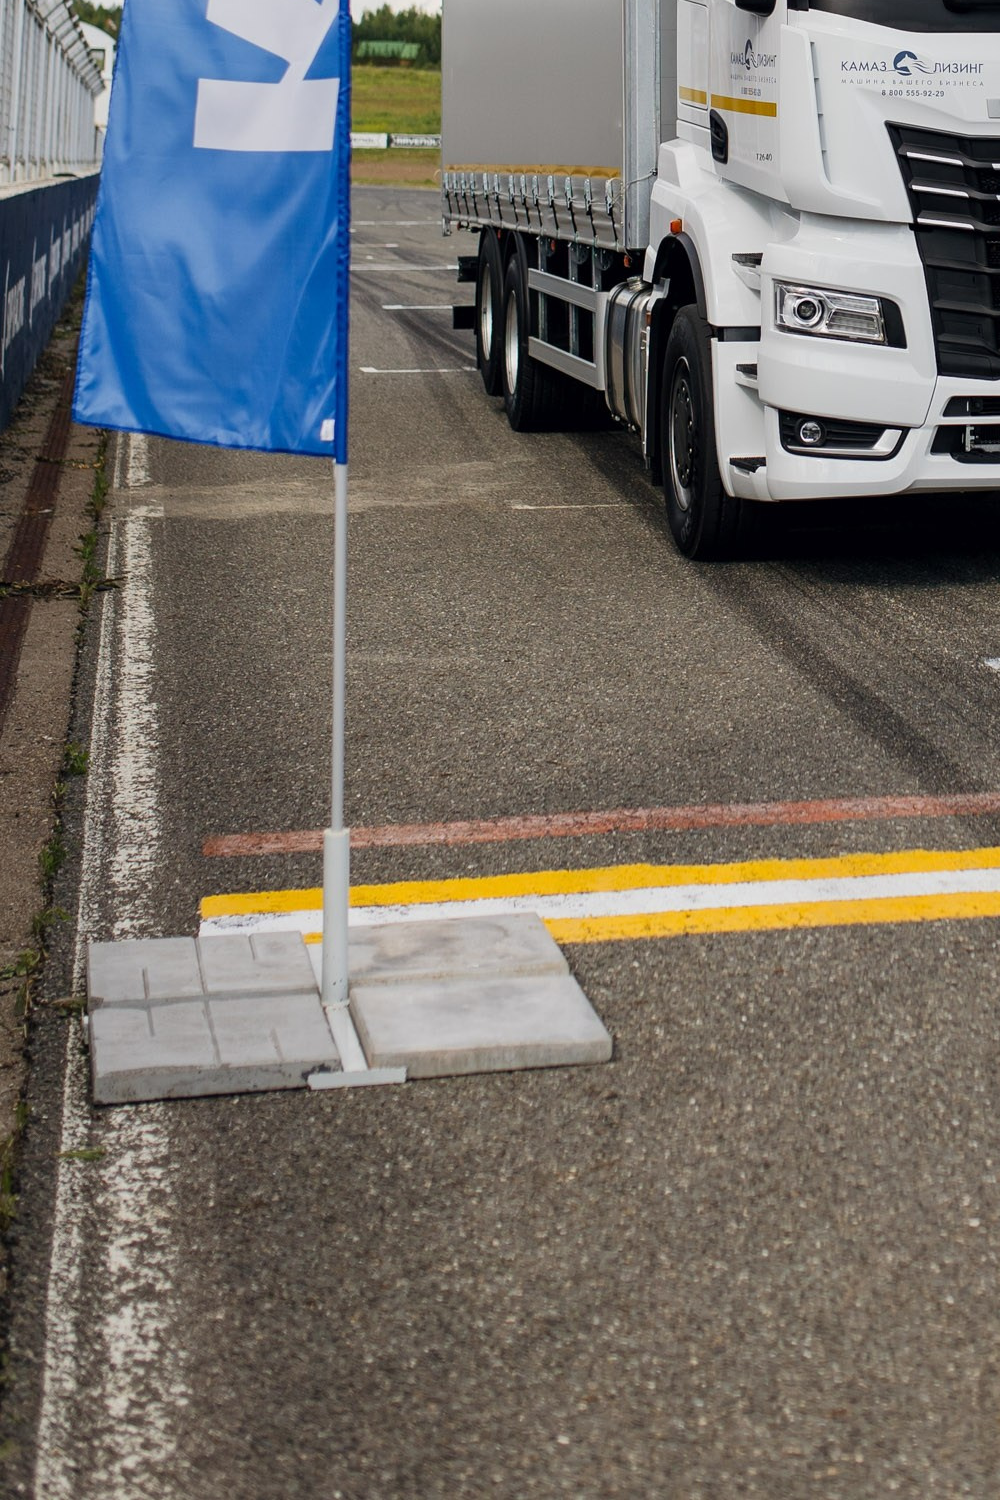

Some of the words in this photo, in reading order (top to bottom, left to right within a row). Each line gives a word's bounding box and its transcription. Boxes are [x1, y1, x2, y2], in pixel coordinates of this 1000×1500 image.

[840, 61, 887, 72] КАМАЗ
[933, 62, 984, 74] ЛИЗИНГ
[888, 89, 904, 97] 800
